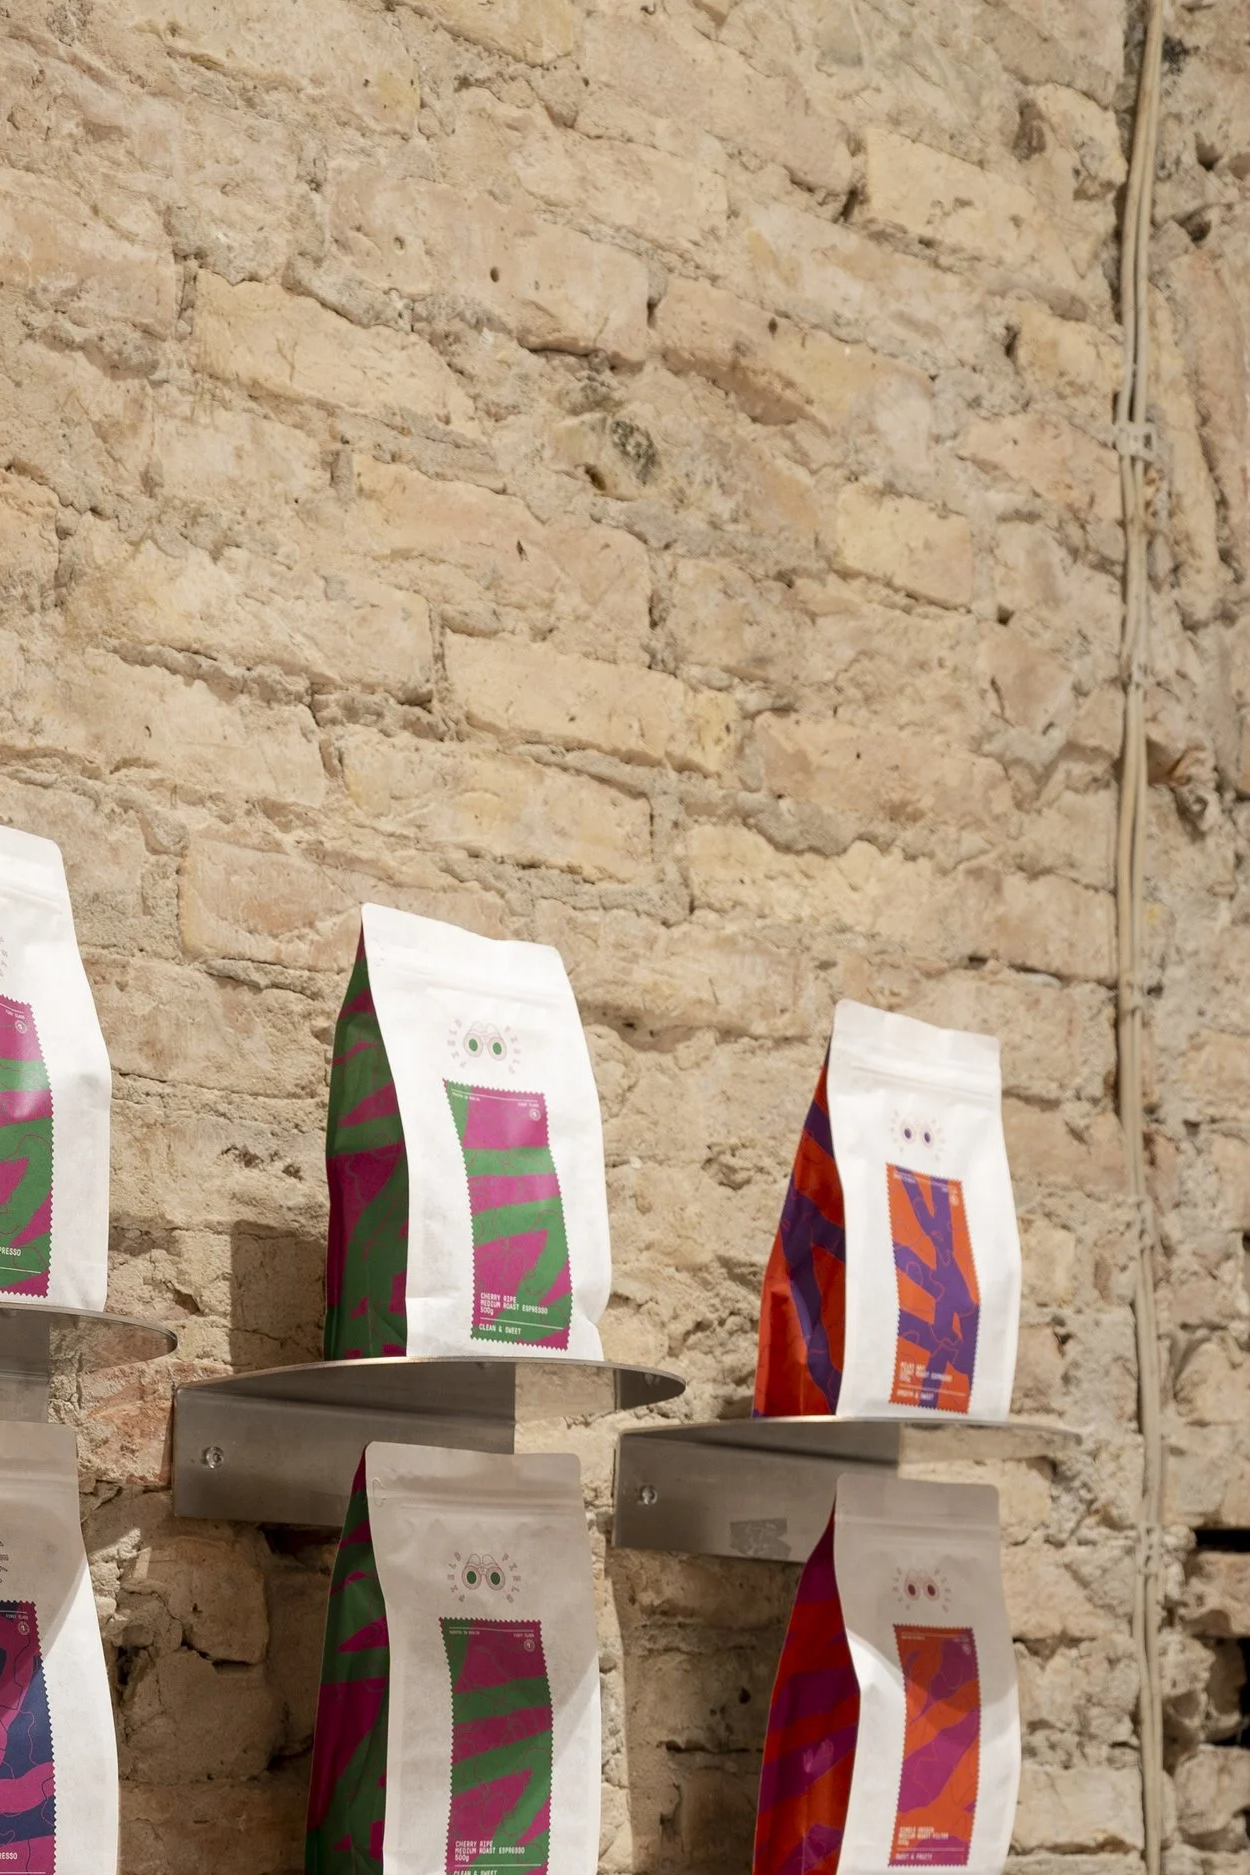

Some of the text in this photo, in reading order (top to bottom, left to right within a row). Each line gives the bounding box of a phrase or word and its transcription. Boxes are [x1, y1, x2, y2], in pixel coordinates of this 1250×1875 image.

[480, 1299, 548, 1314] MEDIUM ROAST ESPRESSO
[480, 1306, 493, 1315] 500g
[479, 1324, 496, 1332] CLEAN
[505, 1327, 521, 1335] SWEET
